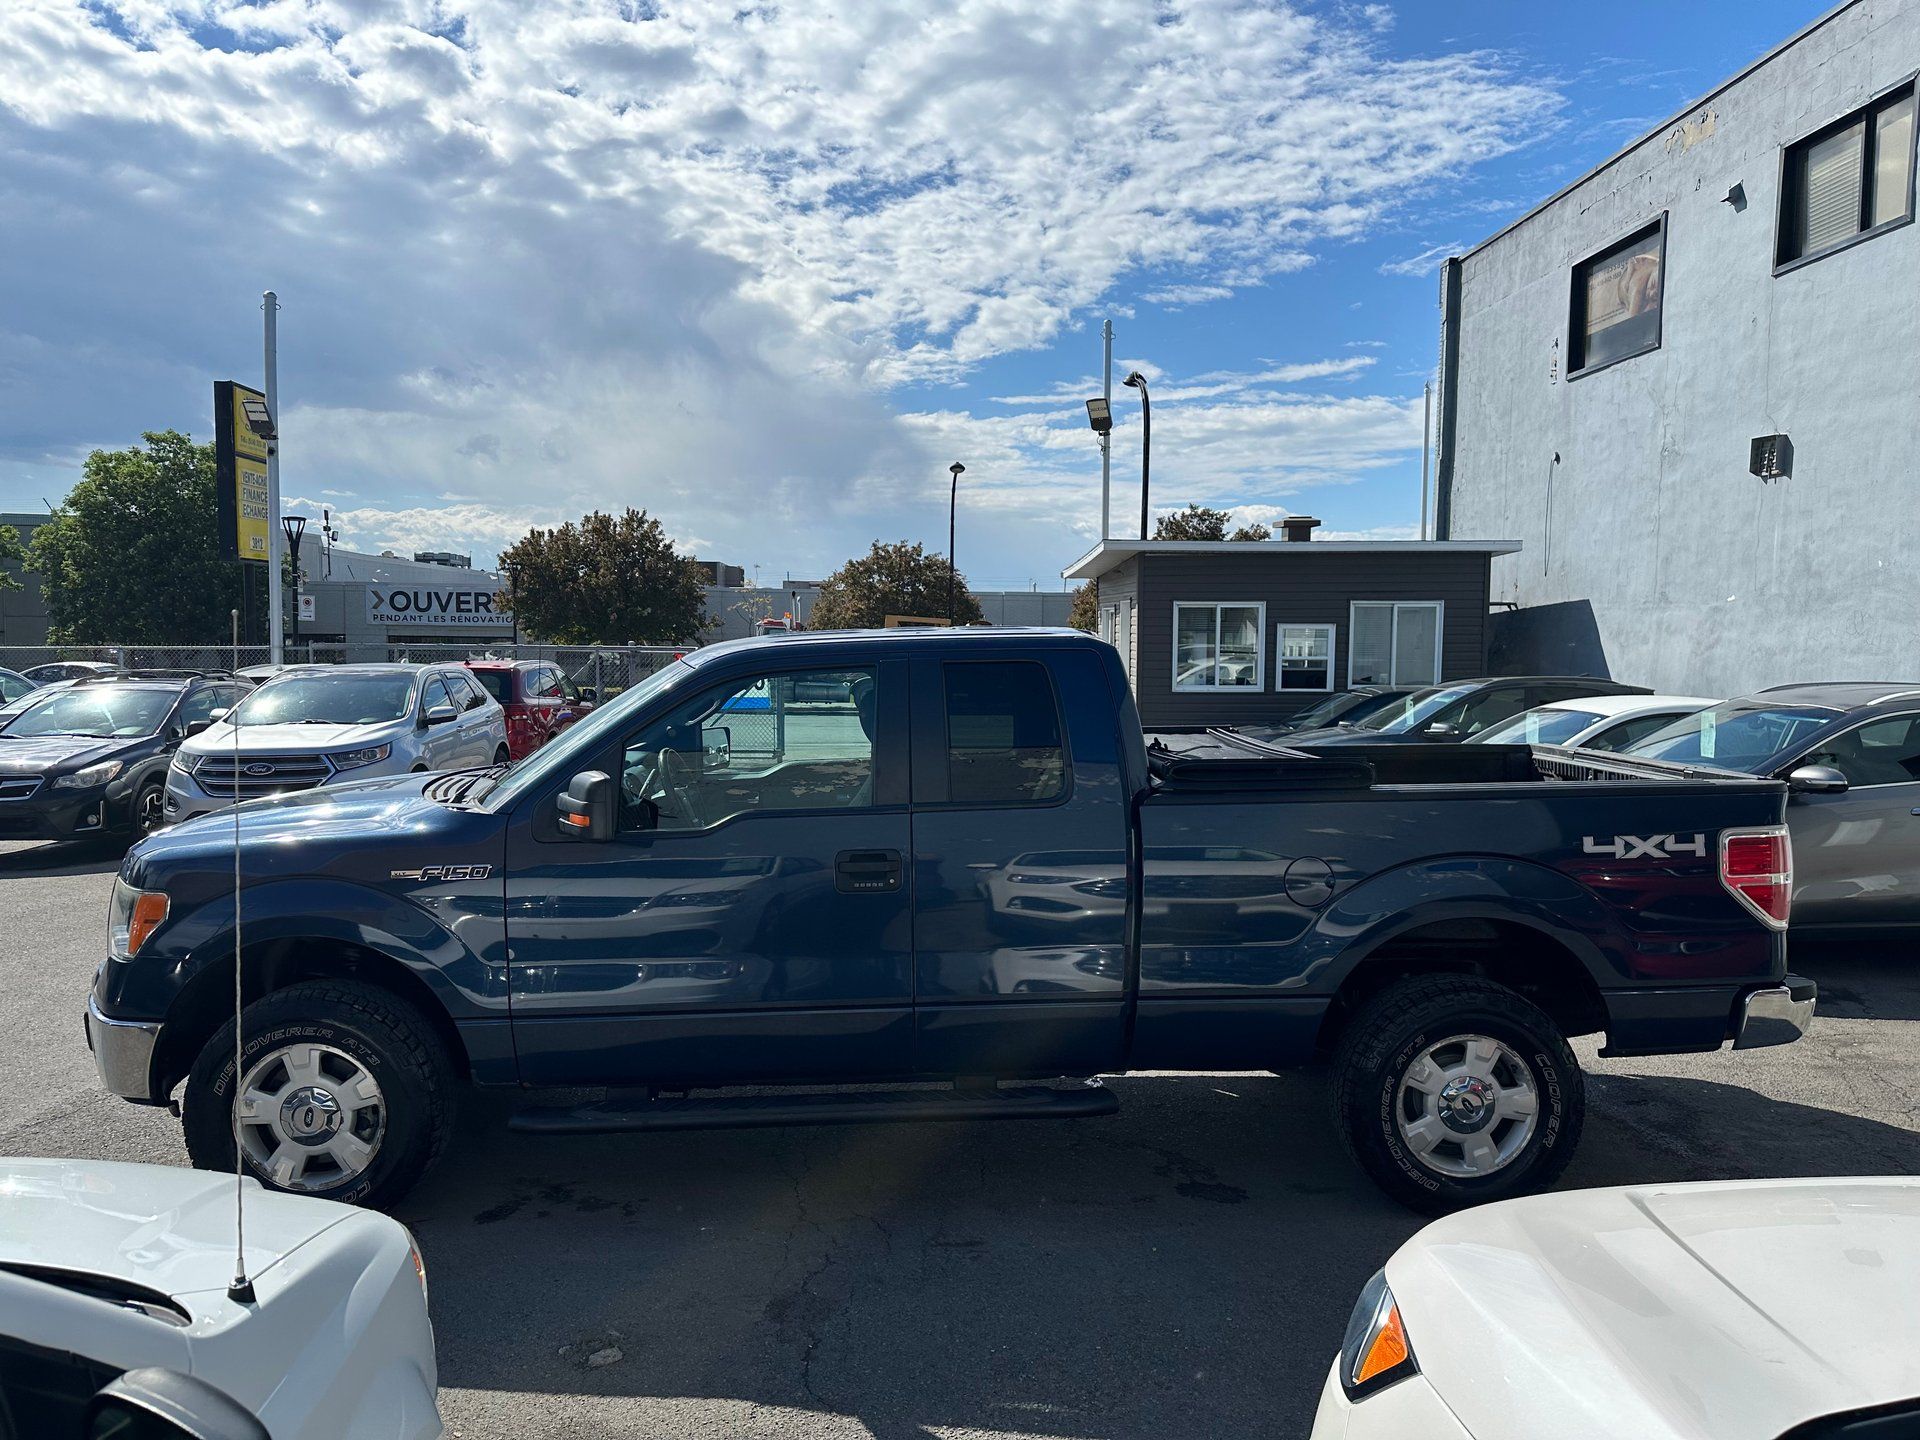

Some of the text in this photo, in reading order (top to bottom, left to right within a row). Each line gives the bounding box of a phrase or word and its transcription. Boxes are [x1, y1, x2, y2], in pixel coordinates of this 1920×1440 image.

[373, 614, 423, 622] PENDANT
[389, 590, 498, 613] OUVER
[418, 864, 492, 881] F-150
[213, 1026, 381, 1096] DISCOVERER AT3
[1535, 1052, 1561, 1149] COOPER
[1381, 1075, 1440, 1191] DISCOVERER
